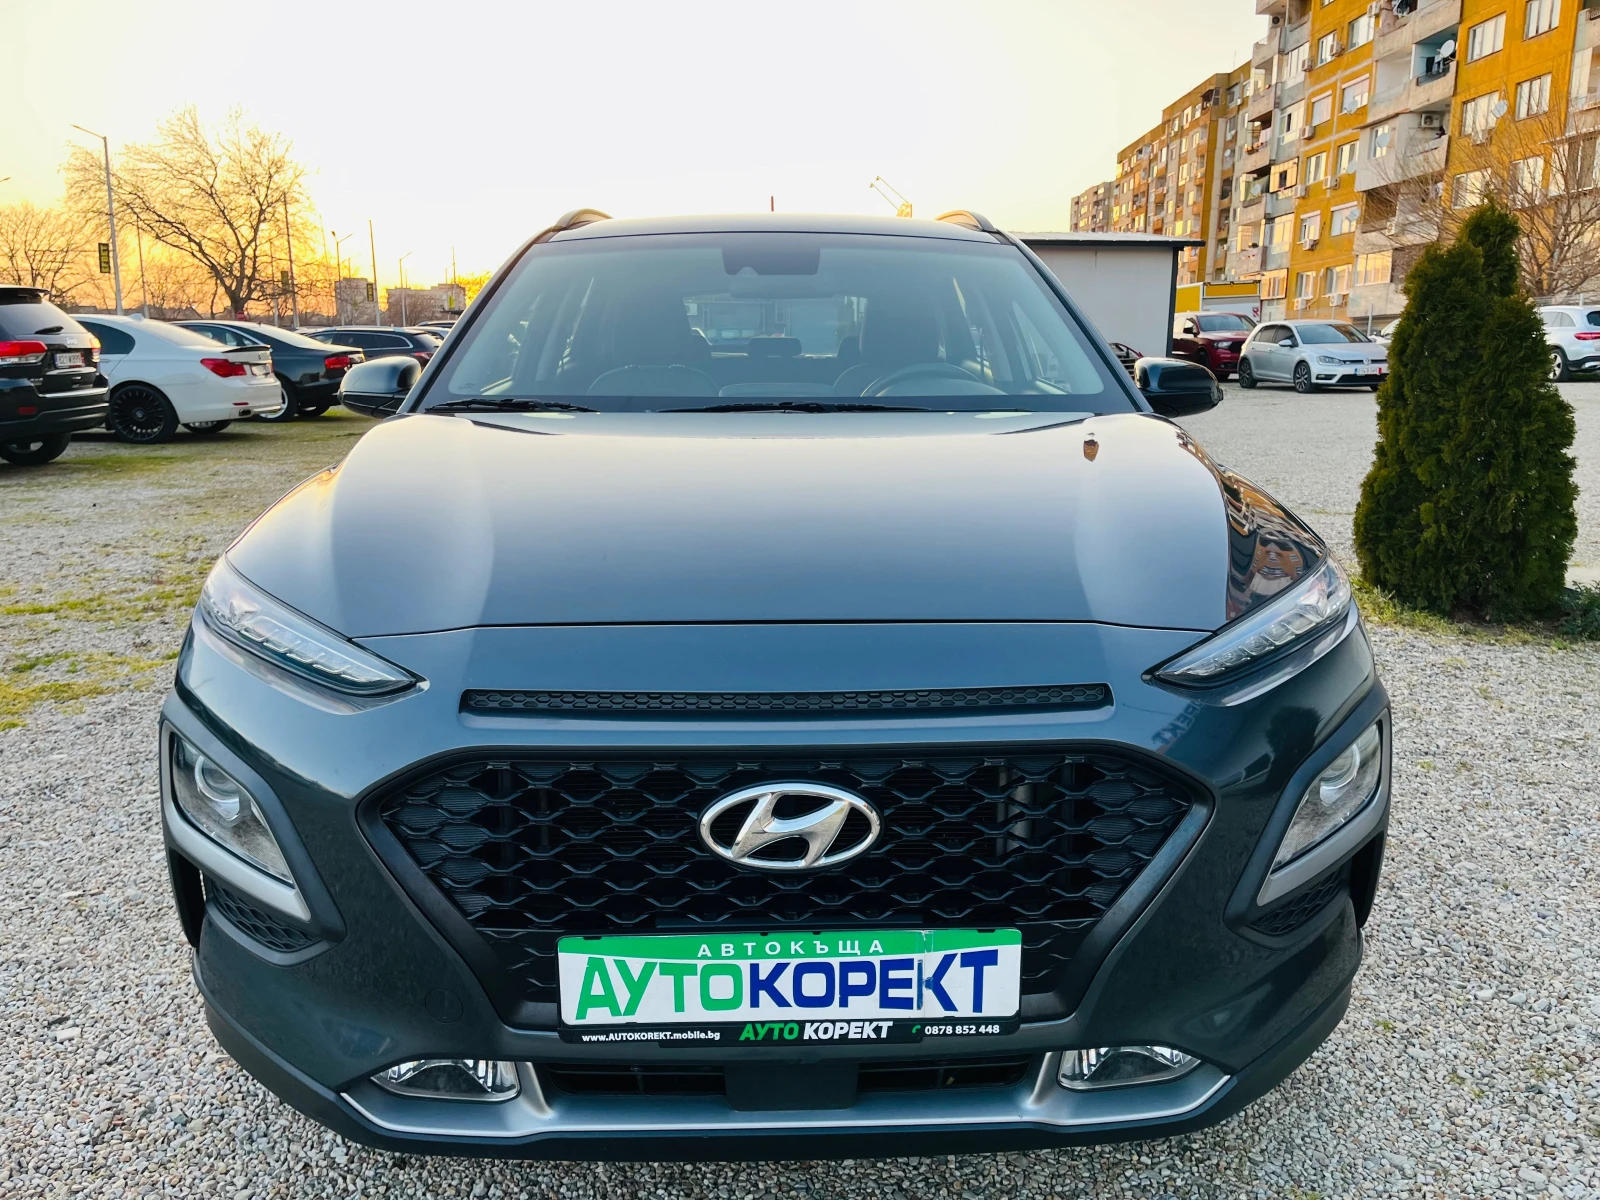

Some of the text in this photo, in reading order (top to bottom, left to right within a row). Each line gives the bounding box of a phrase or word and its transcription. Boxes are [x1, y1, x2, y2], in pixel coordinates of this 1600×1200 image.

[697, 939, 884, 958] АВТОКЪЩА
[575, 949, 998, 1021] АУТОКОРЕКТ
[582, 1030, 721, 1042] www.AUTOKOREKT.mobile.bg
[739, 1021, 894, 1041] АУТО КОРЕКТ
[924, 1024, 1000, 1035] 0878 852 448
